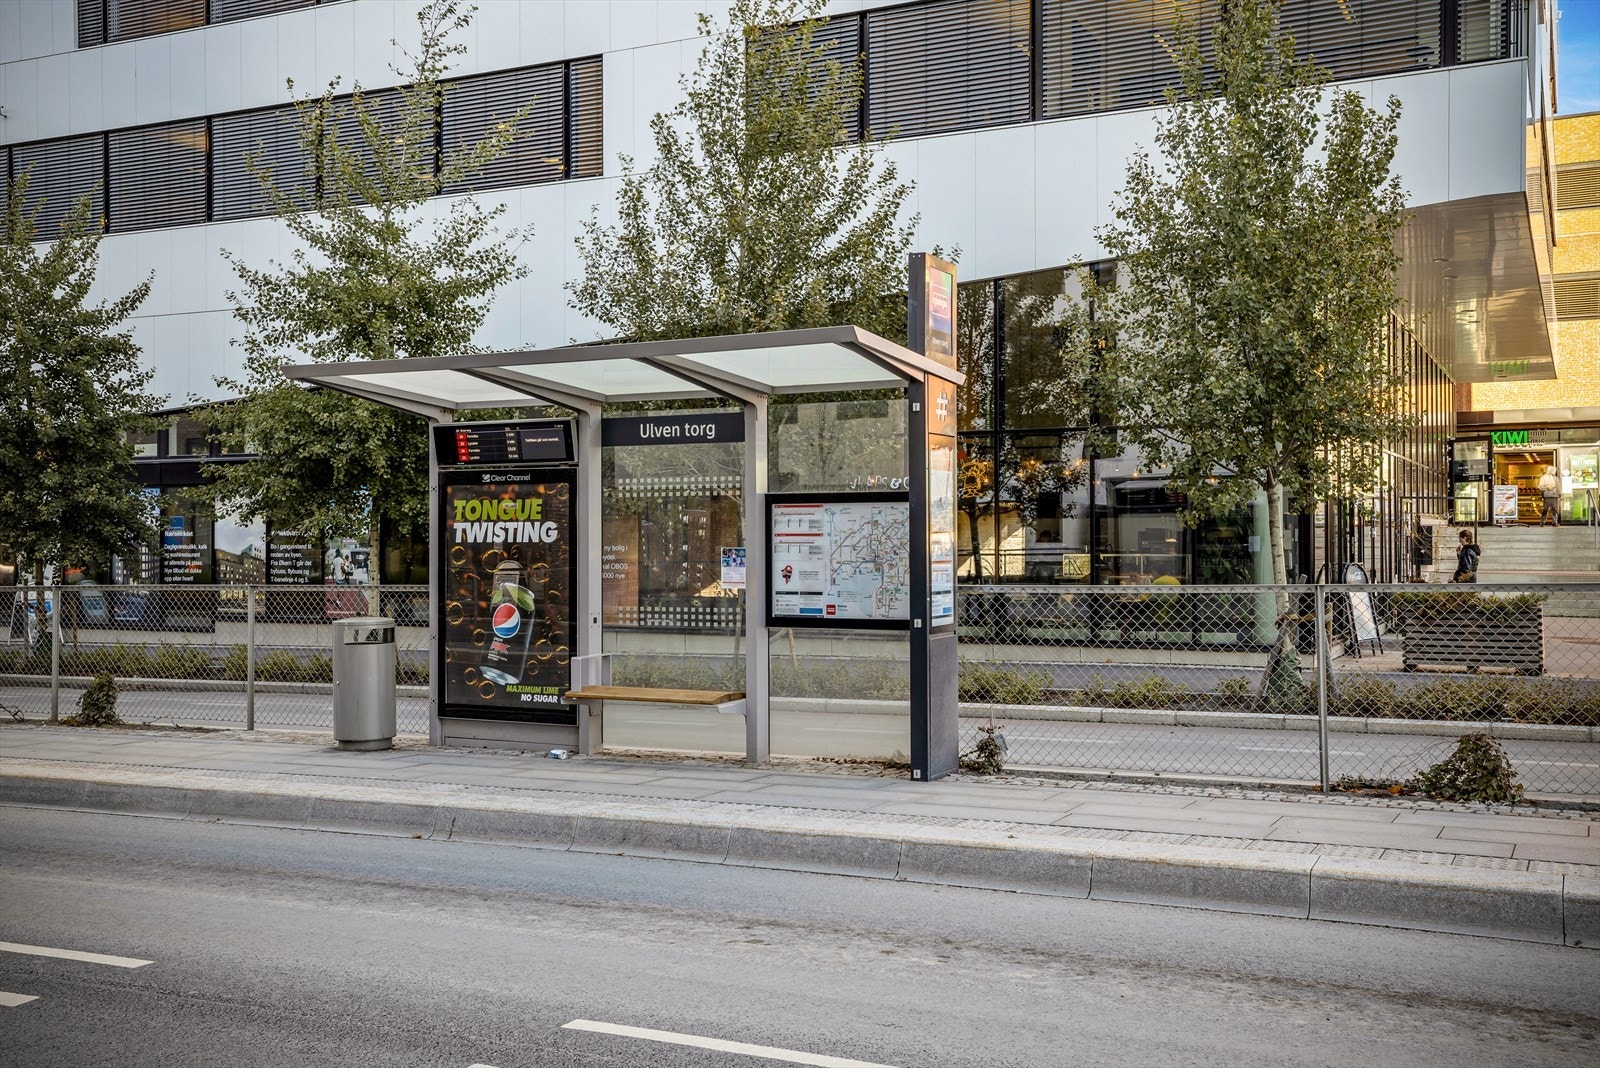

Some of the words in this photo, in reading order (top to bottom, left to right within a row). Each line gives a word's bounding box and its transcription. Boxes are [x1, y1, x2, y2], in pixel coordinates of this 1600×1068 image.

[640, 423, 680, 439] Ulven
[684, 422, 716, 439] torg
[1490, 430, 1528, 445] KIWI
[490, 474, 506, 482] Clear
[507, 474, 530, 482] Channel
[453, 498, 543, 521] TONGUE
[453, 520, 559, 544] TWISTING
[611, 544, 625, 552] bolig
[602, 553, 617, 561] ydel.
[610, 562, 629, 570] OBOS
[505, 684, 542, 694] MAXIMUM
[542, 687, 560, 695] LIME
[520, 693, 533, 702] NO
[533, 694, 558, 703] SUGAR
